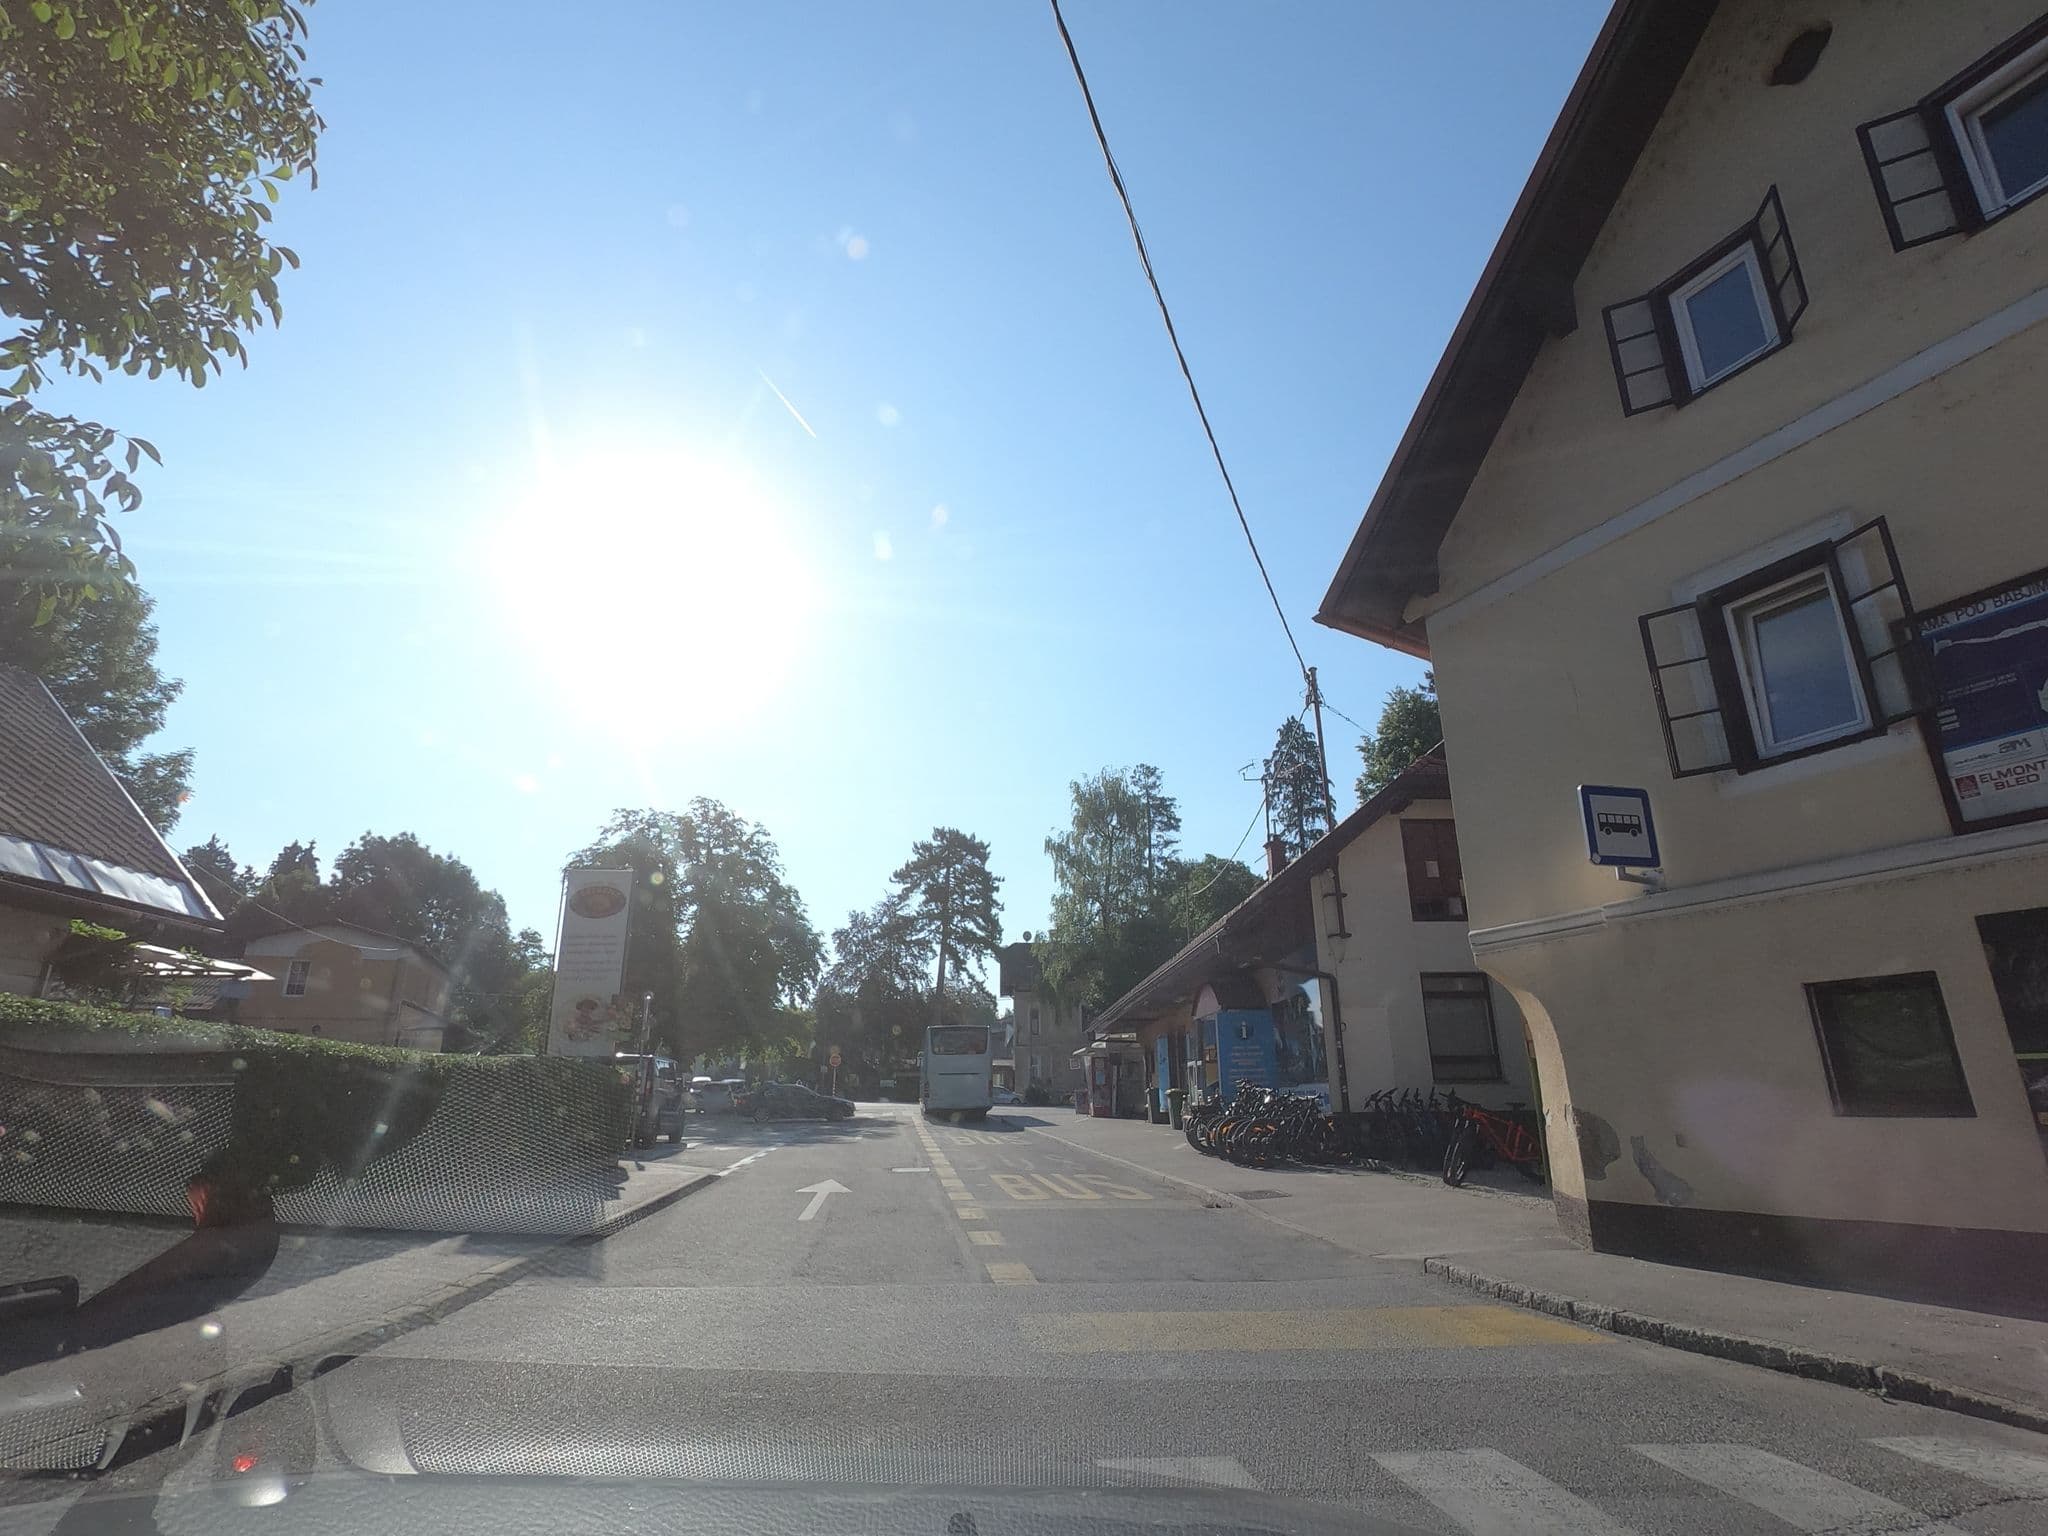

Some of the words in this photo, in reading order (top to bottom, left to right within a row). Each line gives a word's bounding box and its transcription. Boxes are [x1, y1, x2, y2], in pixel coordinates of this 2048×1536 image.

[1954, 600, 1986, 621] POD
[1979, 759, 2047, 784] ELMONT
[1995, 773, 2041, 791] BLED
[989, 1173, 1152, 1200] BUS
